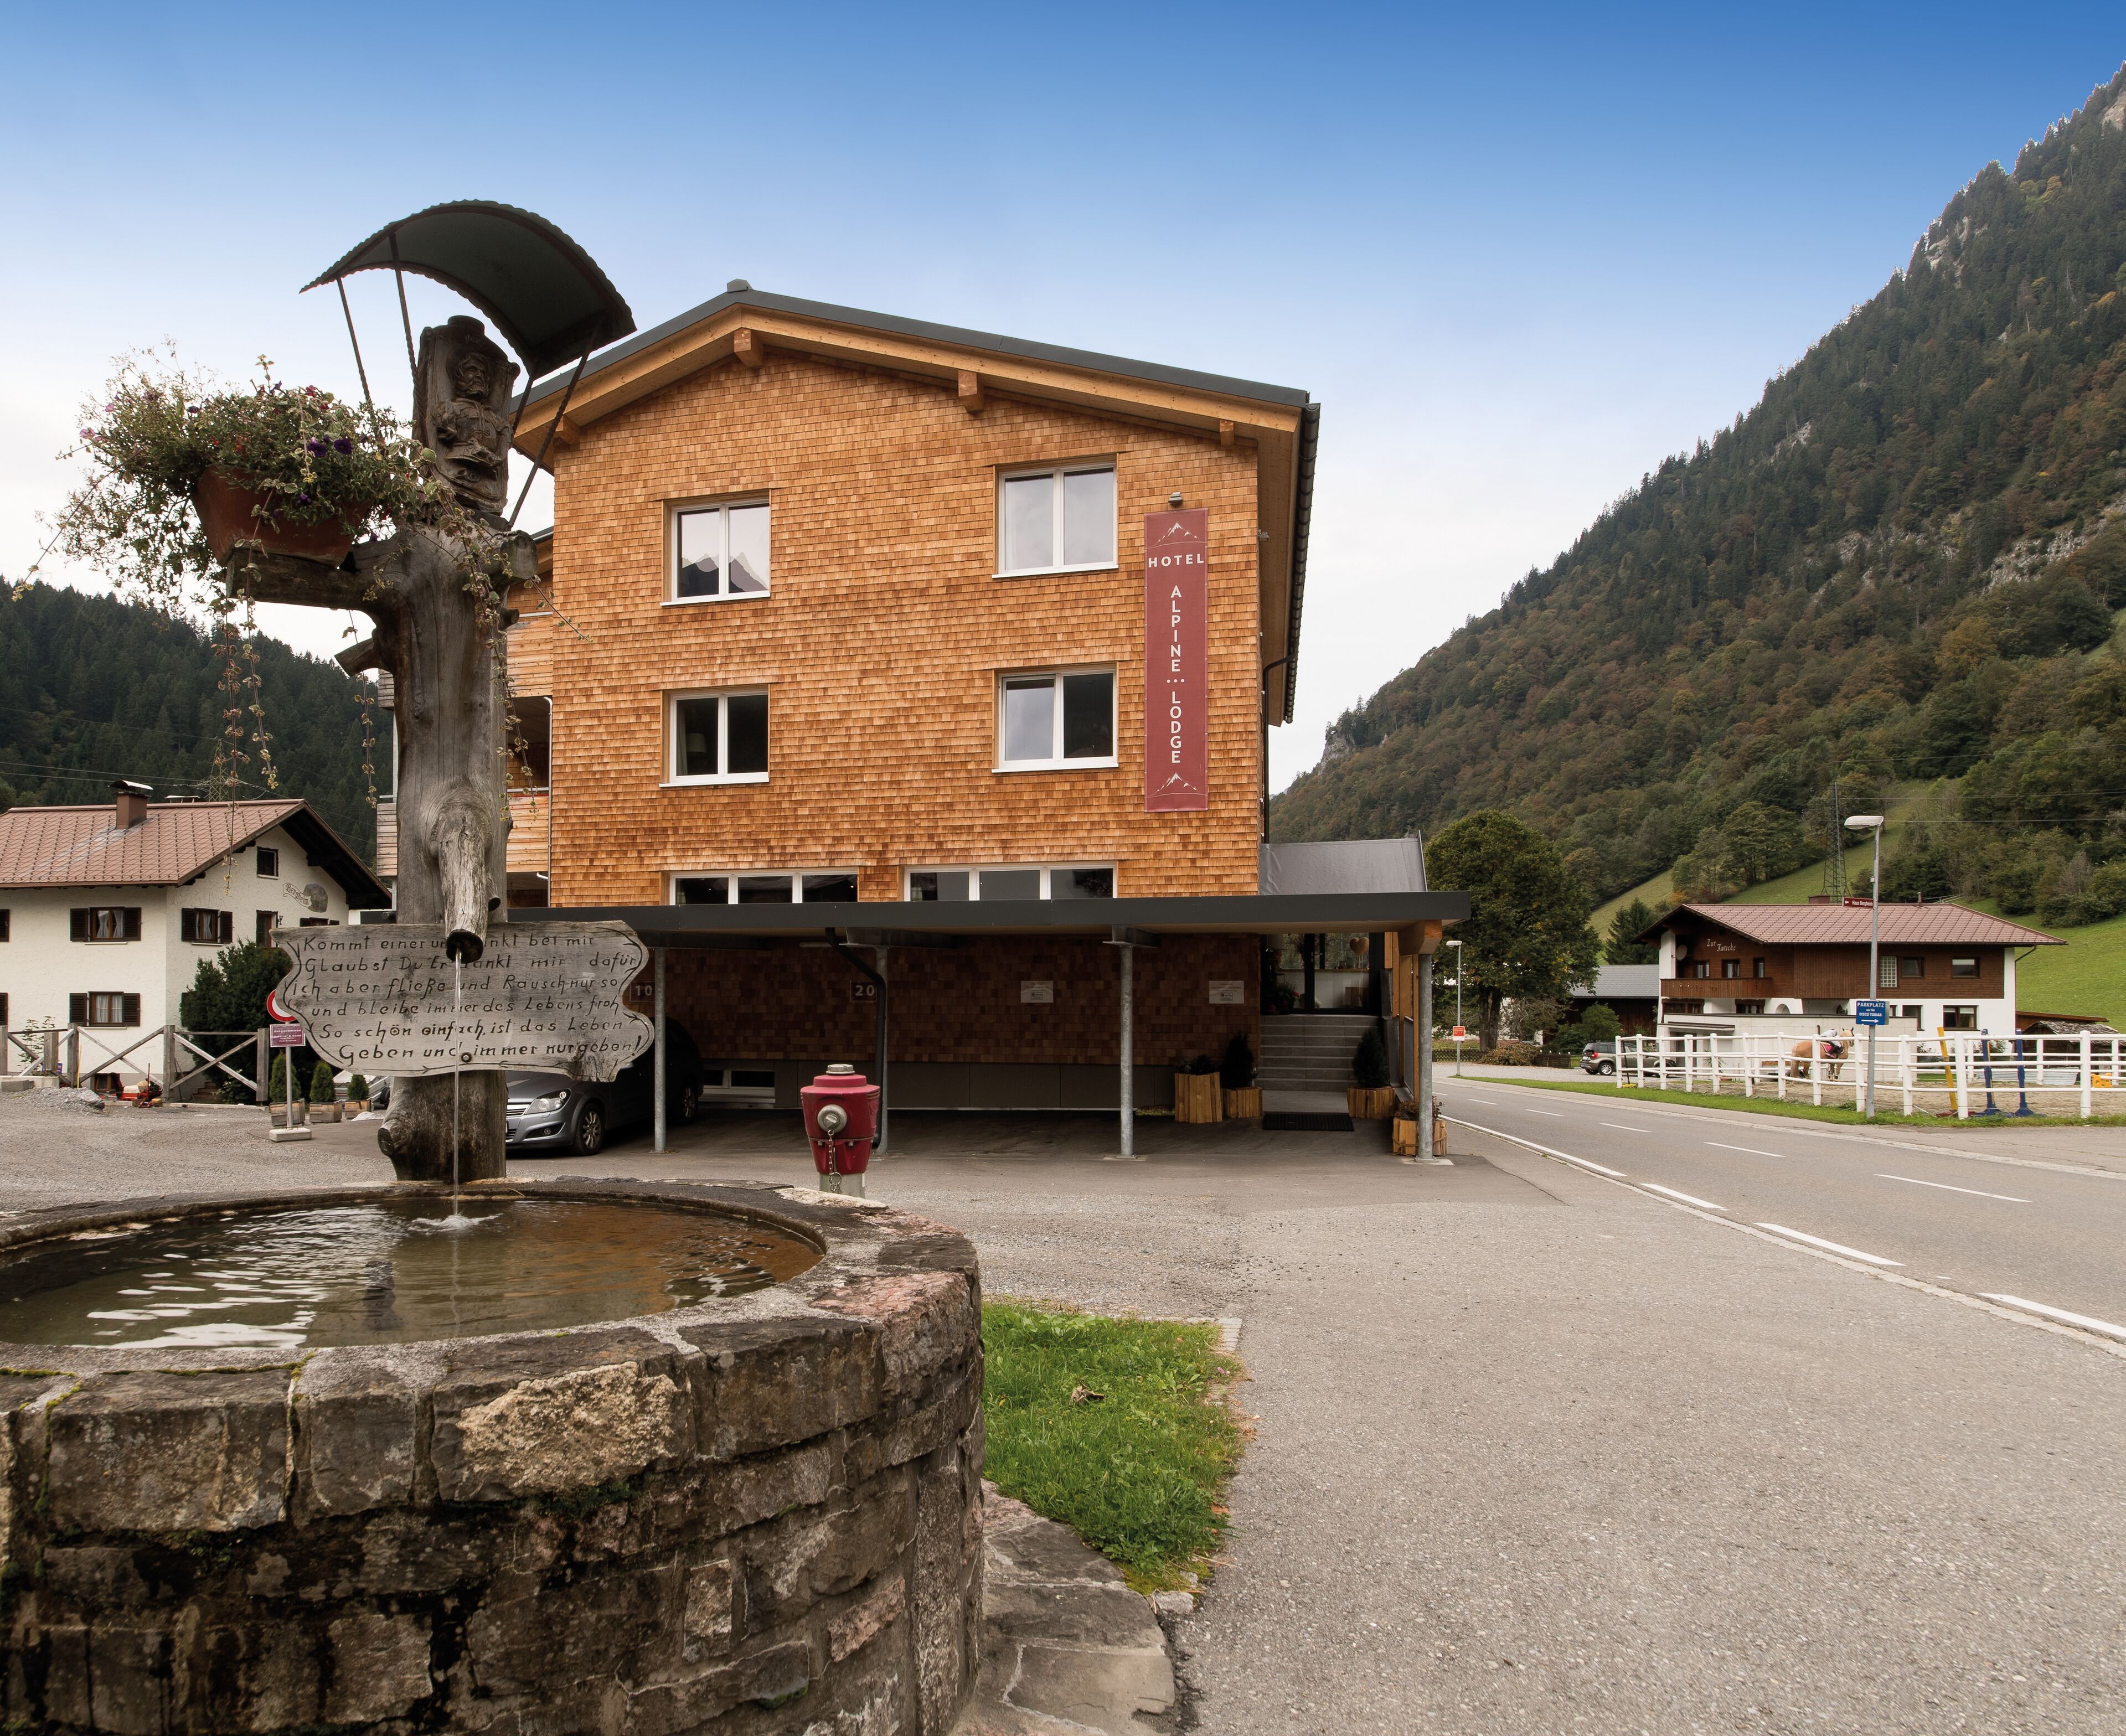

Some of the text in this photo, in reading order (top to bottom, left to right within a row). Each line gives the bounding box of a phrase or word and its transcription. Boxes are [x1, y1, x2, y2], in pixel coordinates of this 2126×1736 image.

[1148, 554, 1204, 567] HOTEL
[1170, 585, 1181, 763] ALPINE LODGE
[286, 884, 309, 905] Bergheim
[304, 936, 370, 951] Kommt
[381, 941, 425, 949] einer
[484, 933, 518, 947] inkt
[529, 933, 556, 946] bei
[567, 936, 594, 946] mir
[399, 957, 422, 969] Du
[531, 957, 565, 967] mir
[589, 952, 636, 973] dafür
[293, 980, 319, 1001] ich
[330, 979, 380, 994] aber
[600, 979, 617, 988] so
[635, 985, 652, 996] 10
[855, 985, 875, 996] 20
[312, 1003, 347, 1016] und
[483, 998, 515, 1012] des
[524, 997, 583, 1011] Lebens
[585, 995, 619, 1016] froh
[319, 1024, 342, 1038] So
[354, 1021, 411, 1043] schön
[490, 1019, 512, 1034] ist
[520, 1019, 556, 1032] das
[567, 1017, 622, 1031] Leben
[339, 1045, 413, 1067] Geben
[473, 1045, 538, 1056] immer
